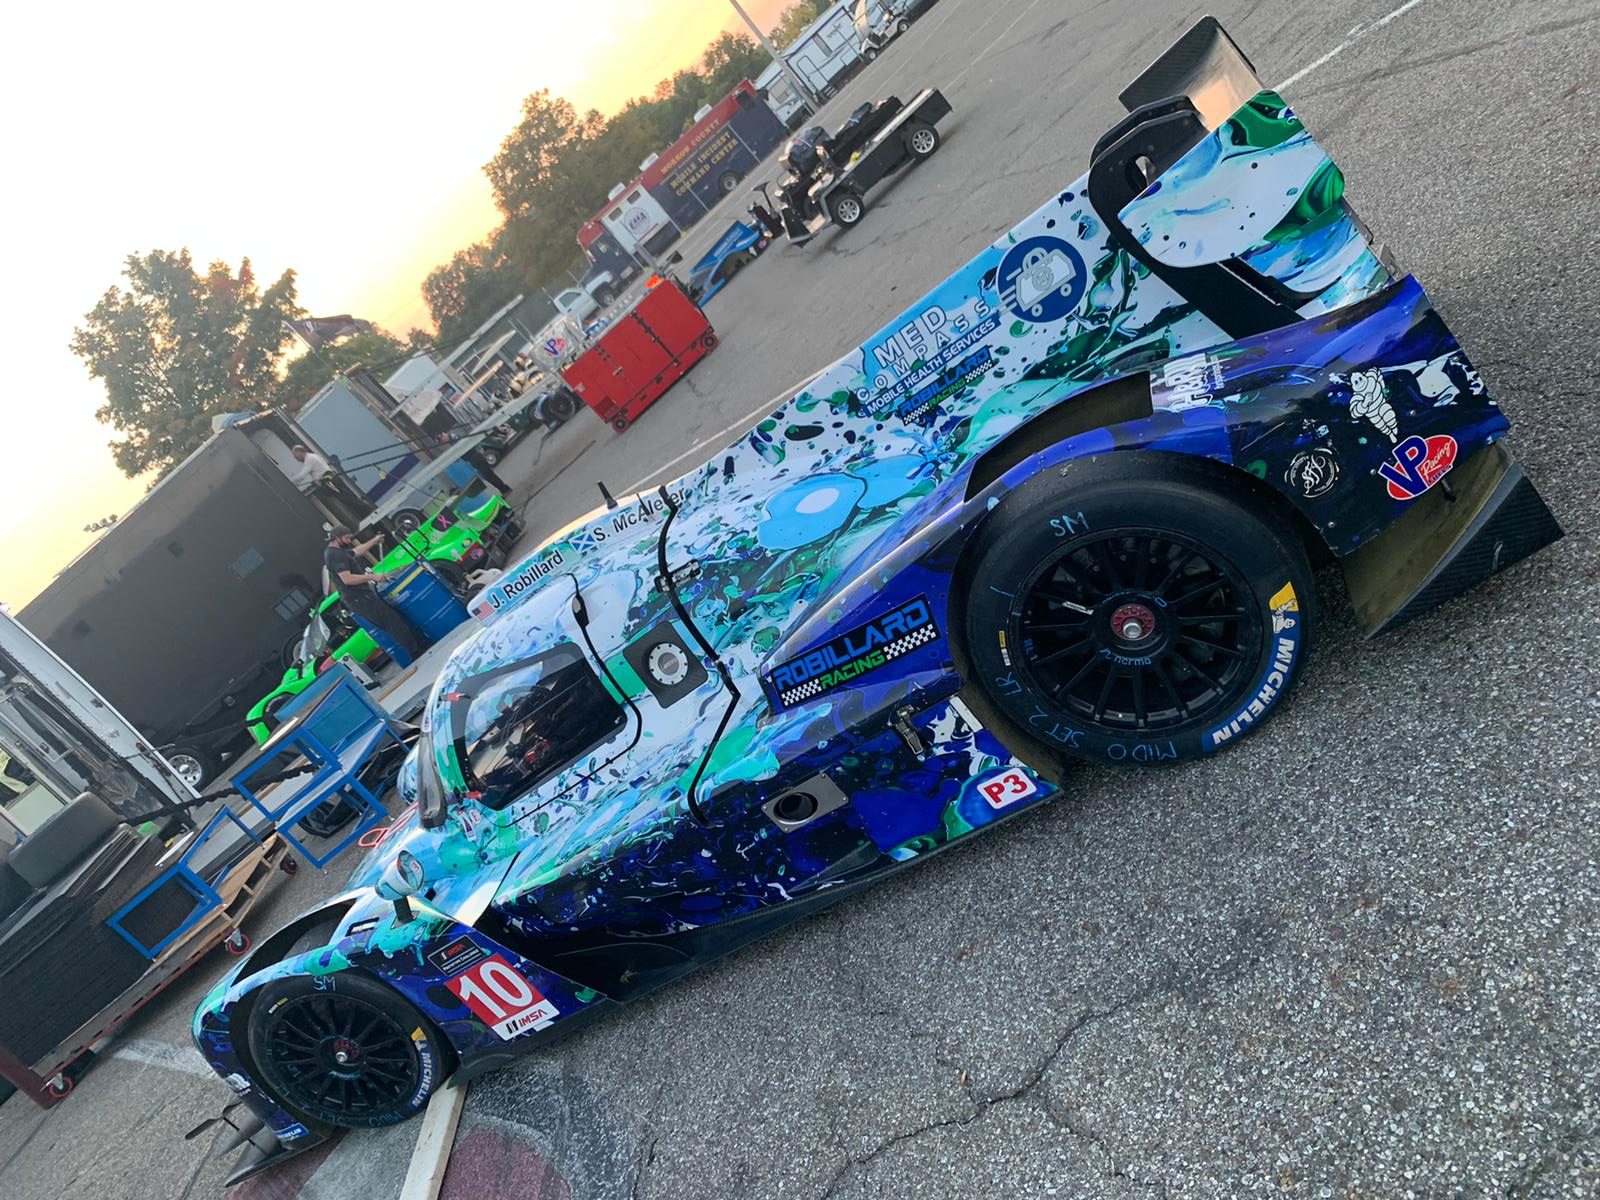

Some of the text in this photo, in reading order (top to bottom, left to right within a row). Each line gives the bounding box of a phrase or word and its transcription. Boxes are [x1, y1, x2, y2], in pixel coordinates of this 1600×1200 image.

[661, 119, 720, 175] MORROW COUNTY
[670, 131, 731, 188] MOBILE INCIDENT
[675, 138, 738, 197] COMMAND CENTER
[856, 300, 991, 402] COMPASS
[872, 304, 947, 369] MED
[866, 318, 997, 416] MOBILE HEALTH SERVICES
[898, 348, 990, 416] ROBILLARD
[928, 378, 966, 408] RACING
[1378, 435, 1428, 496] VP
[1420, 439, 1454, 477] Racing
[593, 527, 611, 541] S.
[1050, 511, 1089, 537] SM
[490, 550, 564, 609] J. Robillard
[774, 600, 929, 690] ROBILLARD
[820, 650, 886, 690] RACING
[1028, 705, 1049, 727] 2
[1212, 637, 1296, 745] MICHELIN
[983, 774, 1028, 804] P3
[314, 975, 336, 991] SM
[460, 961, 533, 1019] 10
[411, 1052, 433, 1107] MICHELIN
